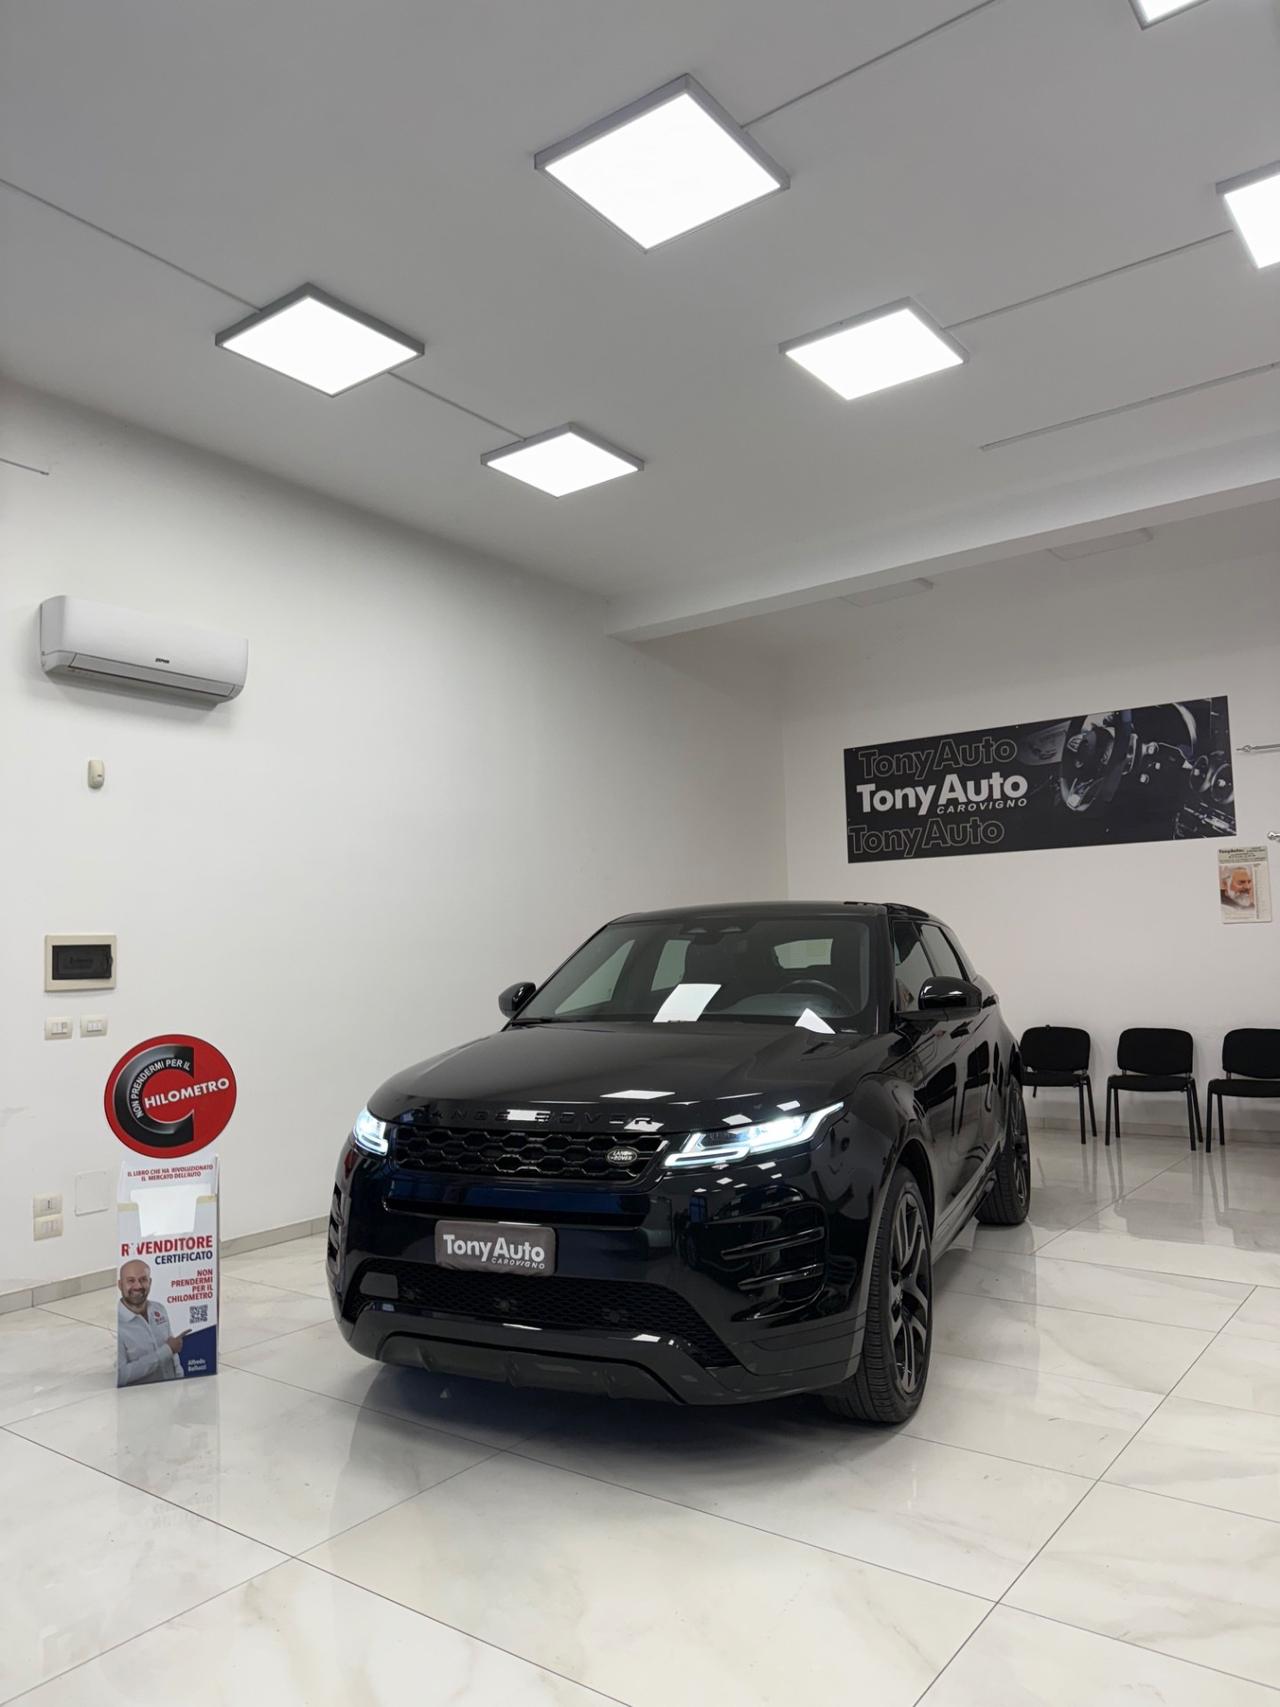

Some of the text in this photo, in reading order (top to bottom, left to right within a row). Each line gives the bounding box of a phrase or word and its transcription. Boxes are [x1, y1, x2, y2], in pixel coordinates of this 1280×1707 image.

[936, 798, 1027, 815] CAROVIGNO
[131, 1058, 192, 1118] NON PRENDERMI PER IL
[133, 1169, 150, 1177] LIBRO
[121, 1235, 213, 1257] RVENDITORE
[154, 1250, 213, 1265] CERTIFICATO
[491, 1257, 545, 1270] CAROVIGNO
[197, 1268, 213, 1277] NON
[171, 1276, 213, 1288] PRENDERMI
[192, 1284, 213, 1293] PER IL
[167, 1291, 213, 1304] CHILOMETRO
